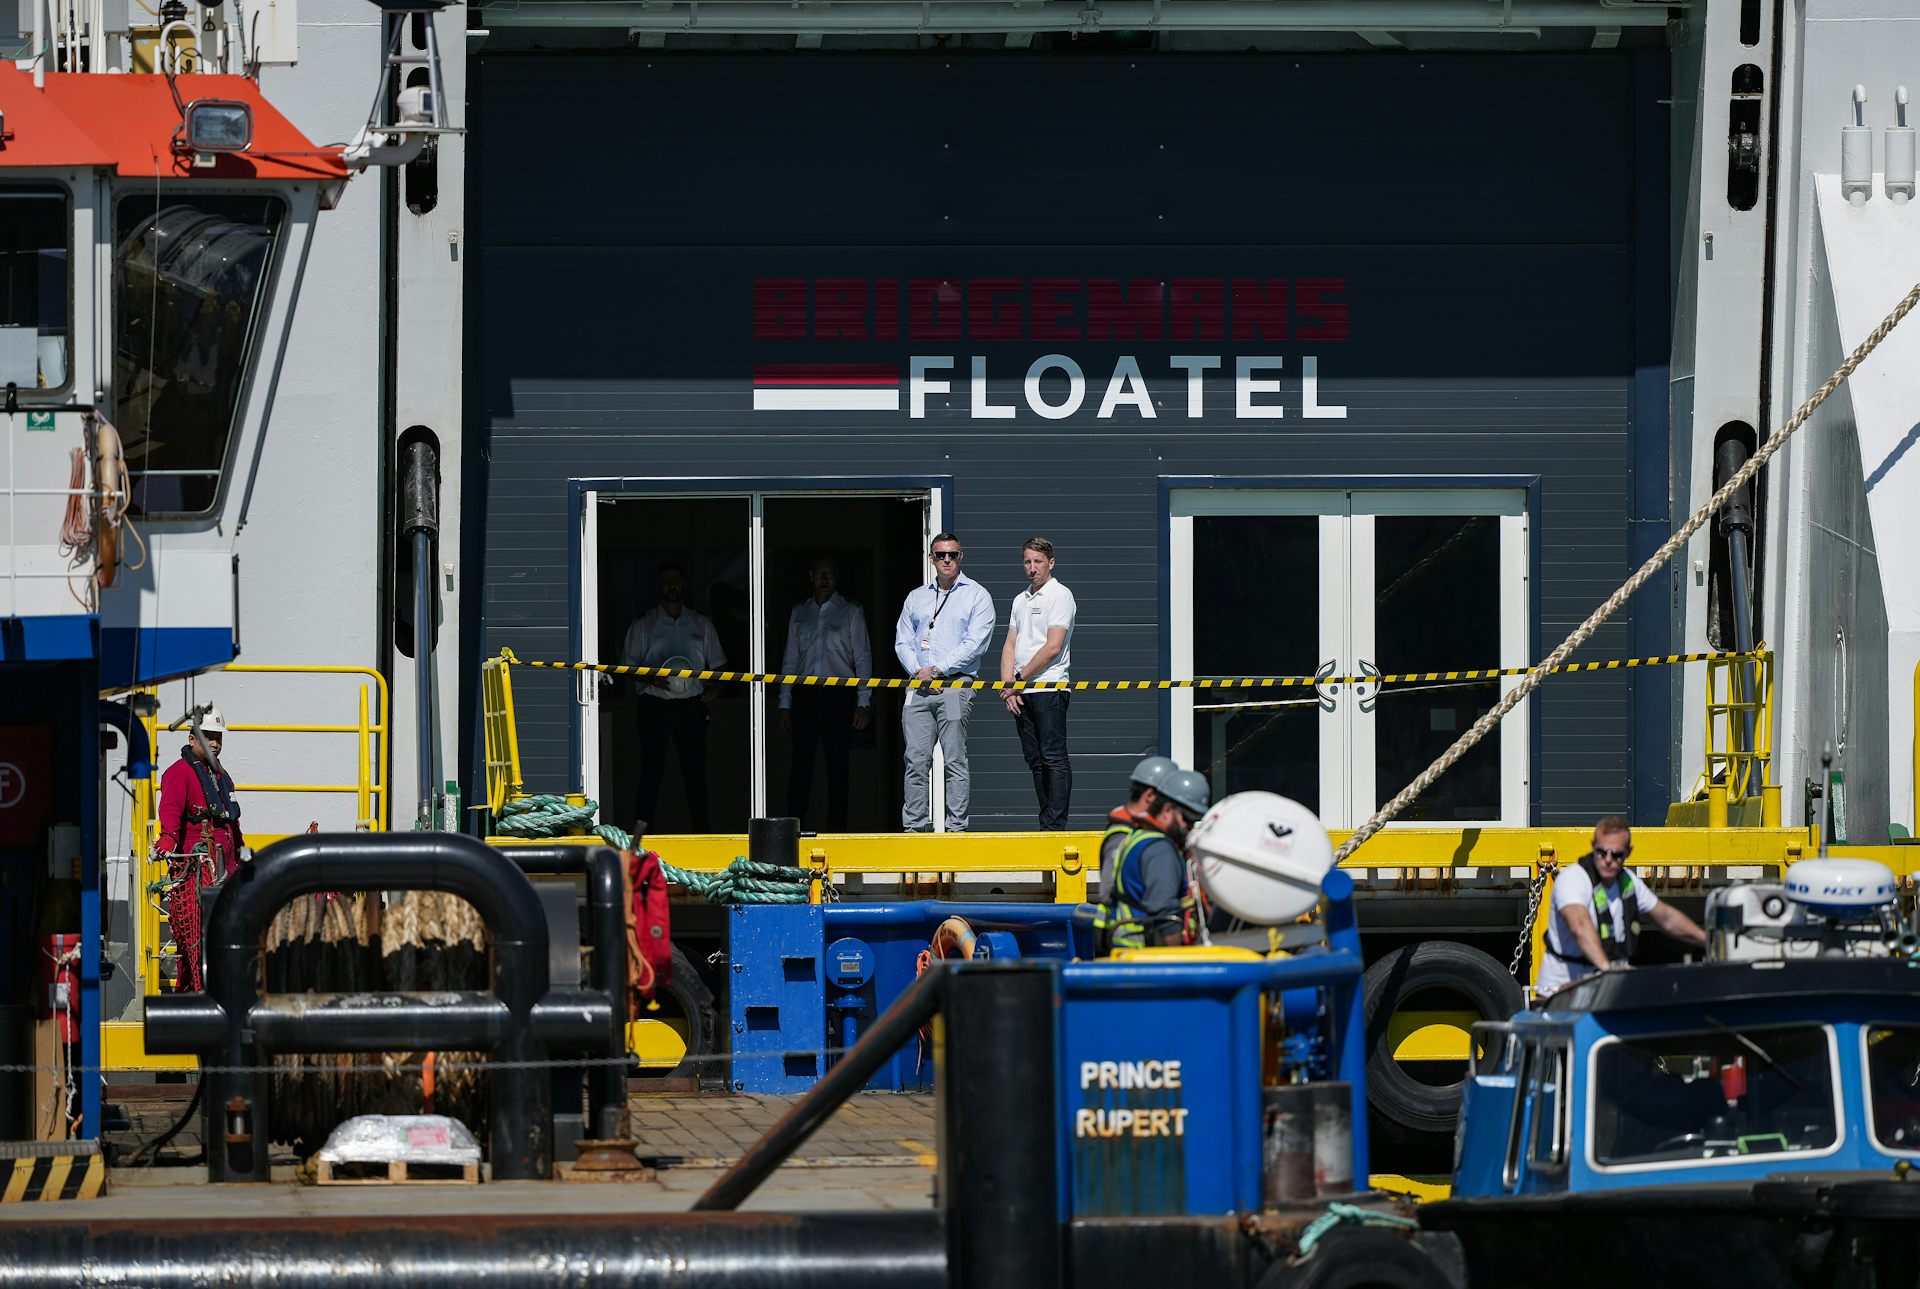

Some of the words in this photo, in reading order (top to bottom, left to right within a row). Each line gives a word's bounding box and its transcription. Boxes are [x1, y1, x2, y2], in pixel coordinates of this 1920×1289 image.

[753, 277, 1349, 341] BRIDGEMANS
[910, 354, 1348, 419] FLOATEL
[1080, 1060, 1182, 1090] PRINCE
[1076, 1108, 1188, 1138] RUPERT
